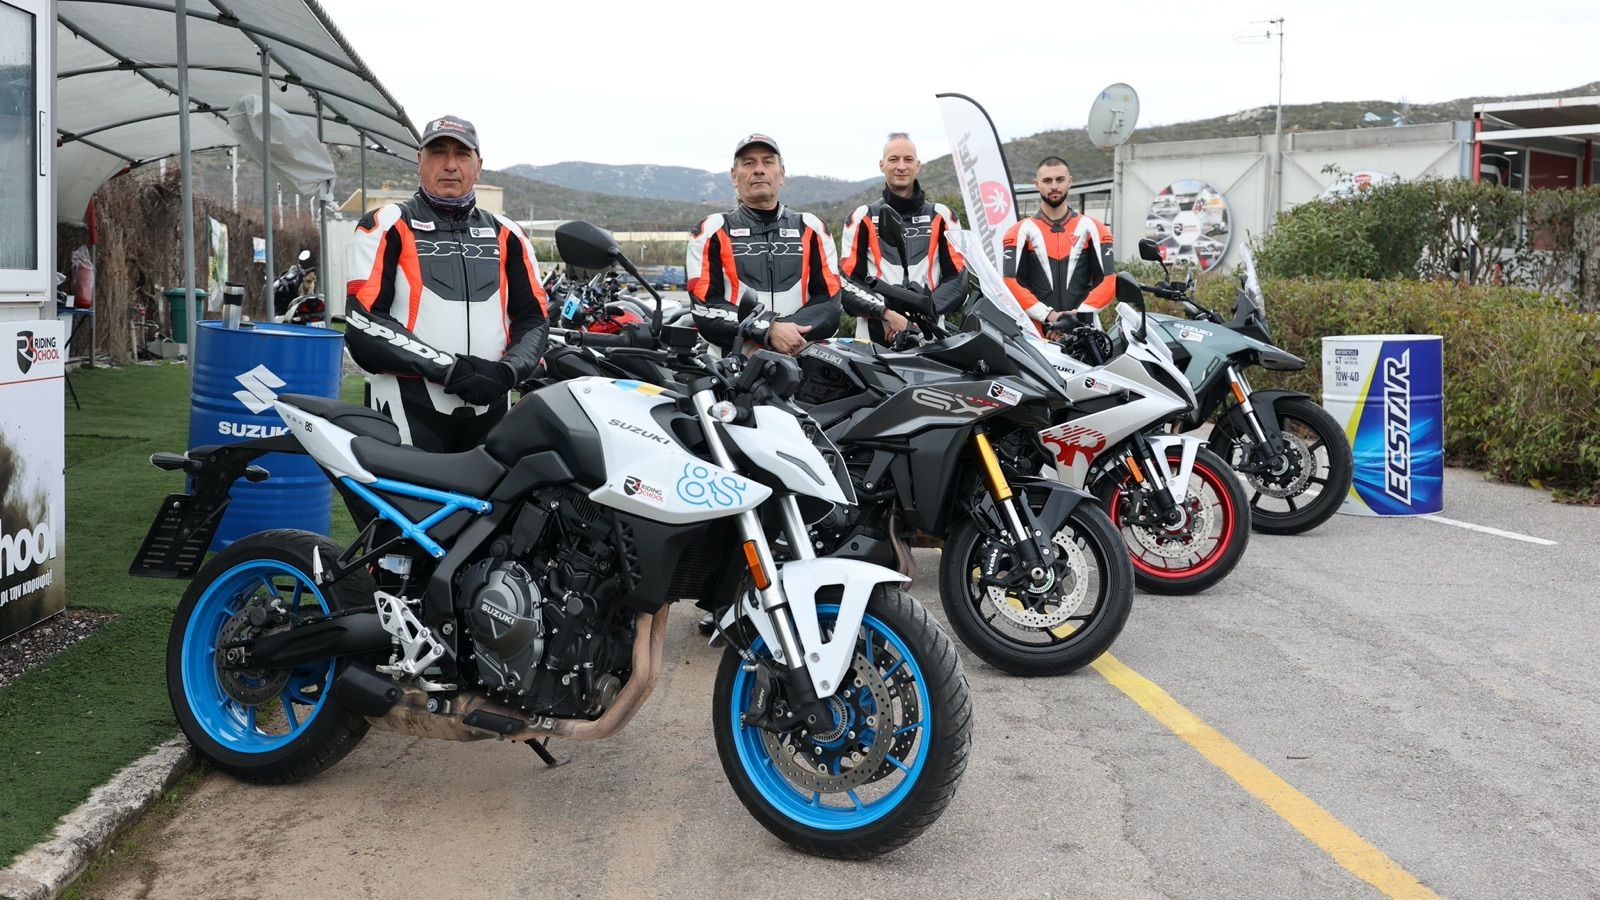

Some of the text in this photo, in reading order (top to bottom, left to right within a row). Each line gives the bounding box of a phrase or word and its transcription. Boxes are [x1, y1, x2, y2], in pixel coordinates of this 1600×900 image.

[1173, 322, 1213, 336] SUZUKI
[34, 336, 56, 348] RIDING
[808, 347, 843, 365] SUZUKI
[1335, 371, 1360, 382] 10W-40
[218, 421, 293, 438] SUZUK
[608, 418, 671, 445] SUZUKI
[1384, 349, 1411, 506] ECSTAR
[641, 484, 663, 496] RIDING
[986, 548, 999, 575] brembo
[481, 603, 516, 625] SUZUKI
